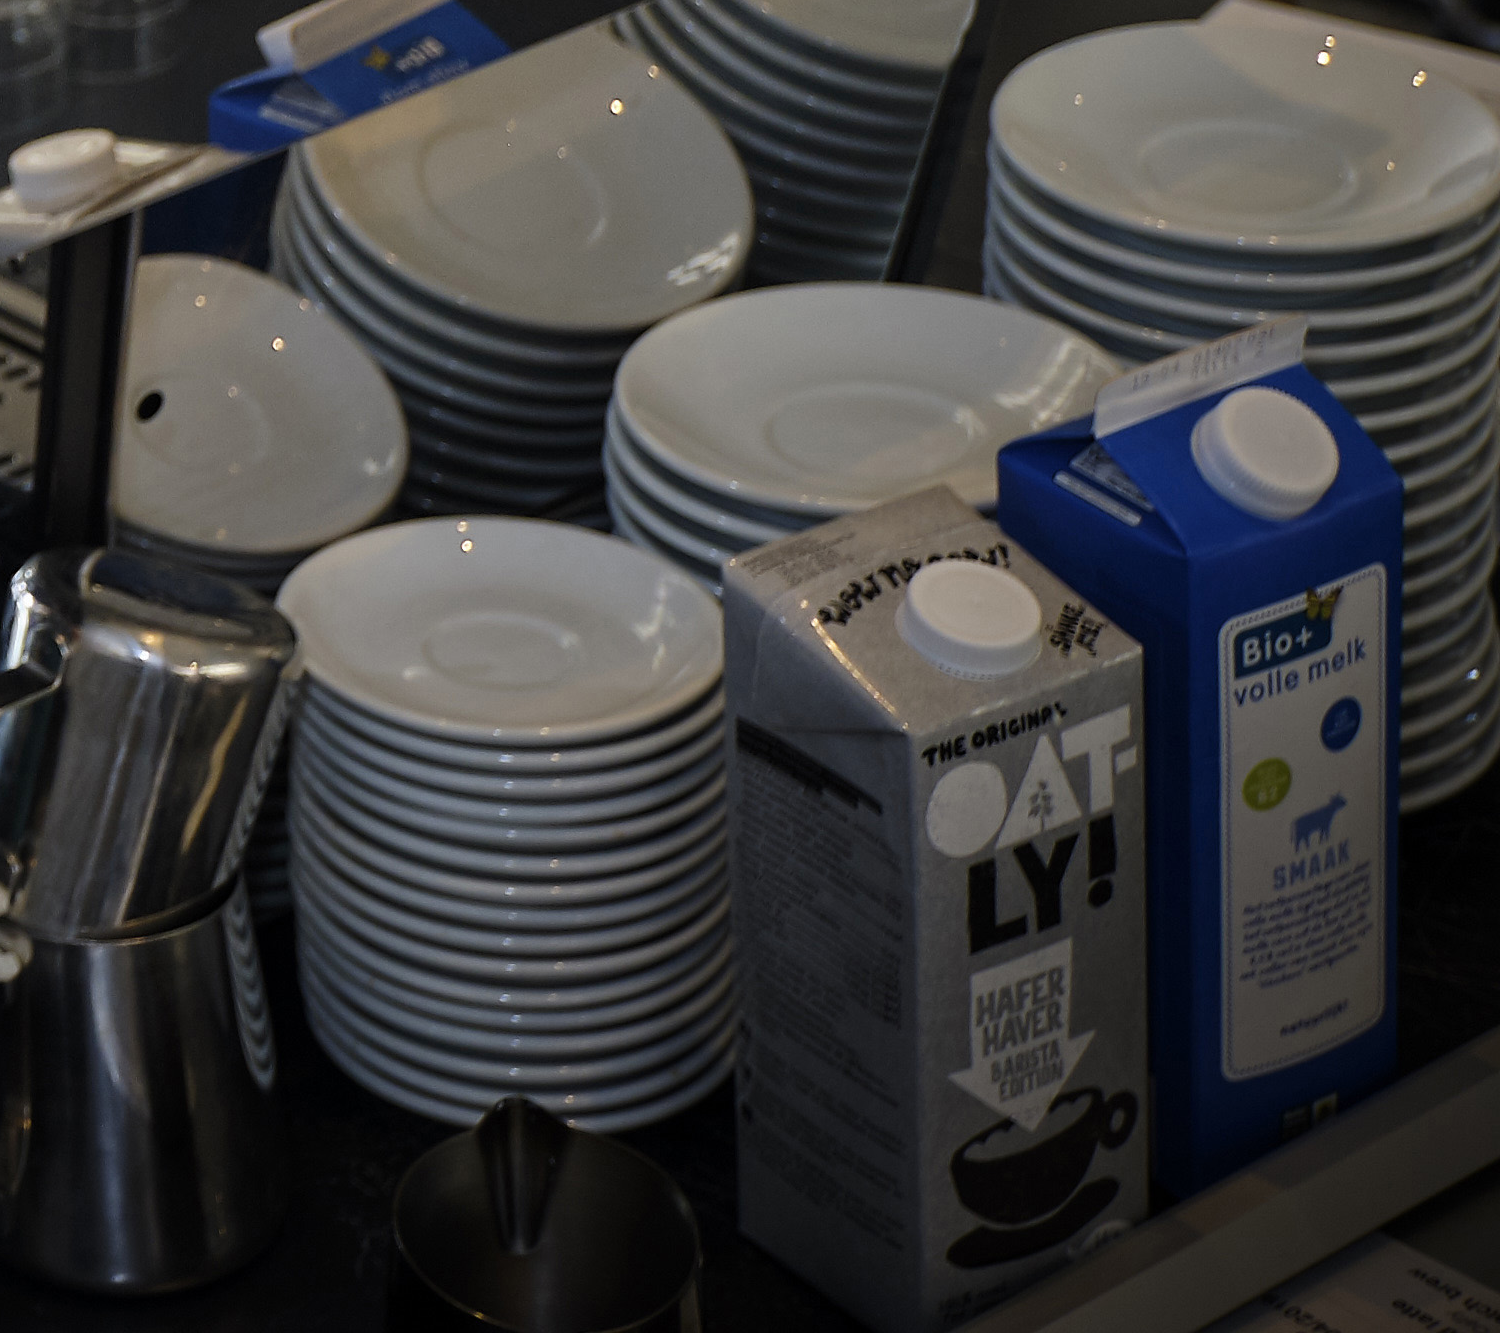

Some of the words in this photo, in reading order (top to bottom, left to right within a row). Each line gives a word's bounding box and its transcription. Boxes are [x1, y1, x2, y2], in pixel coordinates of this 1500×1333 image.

[1233, 669, 1299, 708] volle
[1308, 635, 1368, 684] melk
[1241, 625, 1315, 669] Bio+
[920, 735, 967, 769] THE
[966, 814, 1118, 956] LY!
[1272, 837, 1350, 892] SMAAK
[975, 964, 1065, 1028] HAFER
[981, 1000, 1064, 1059] HAVER
[990, 1038, 1061, 1085] BARISTA
[998, 1057, 1065, 1103] EDITION
